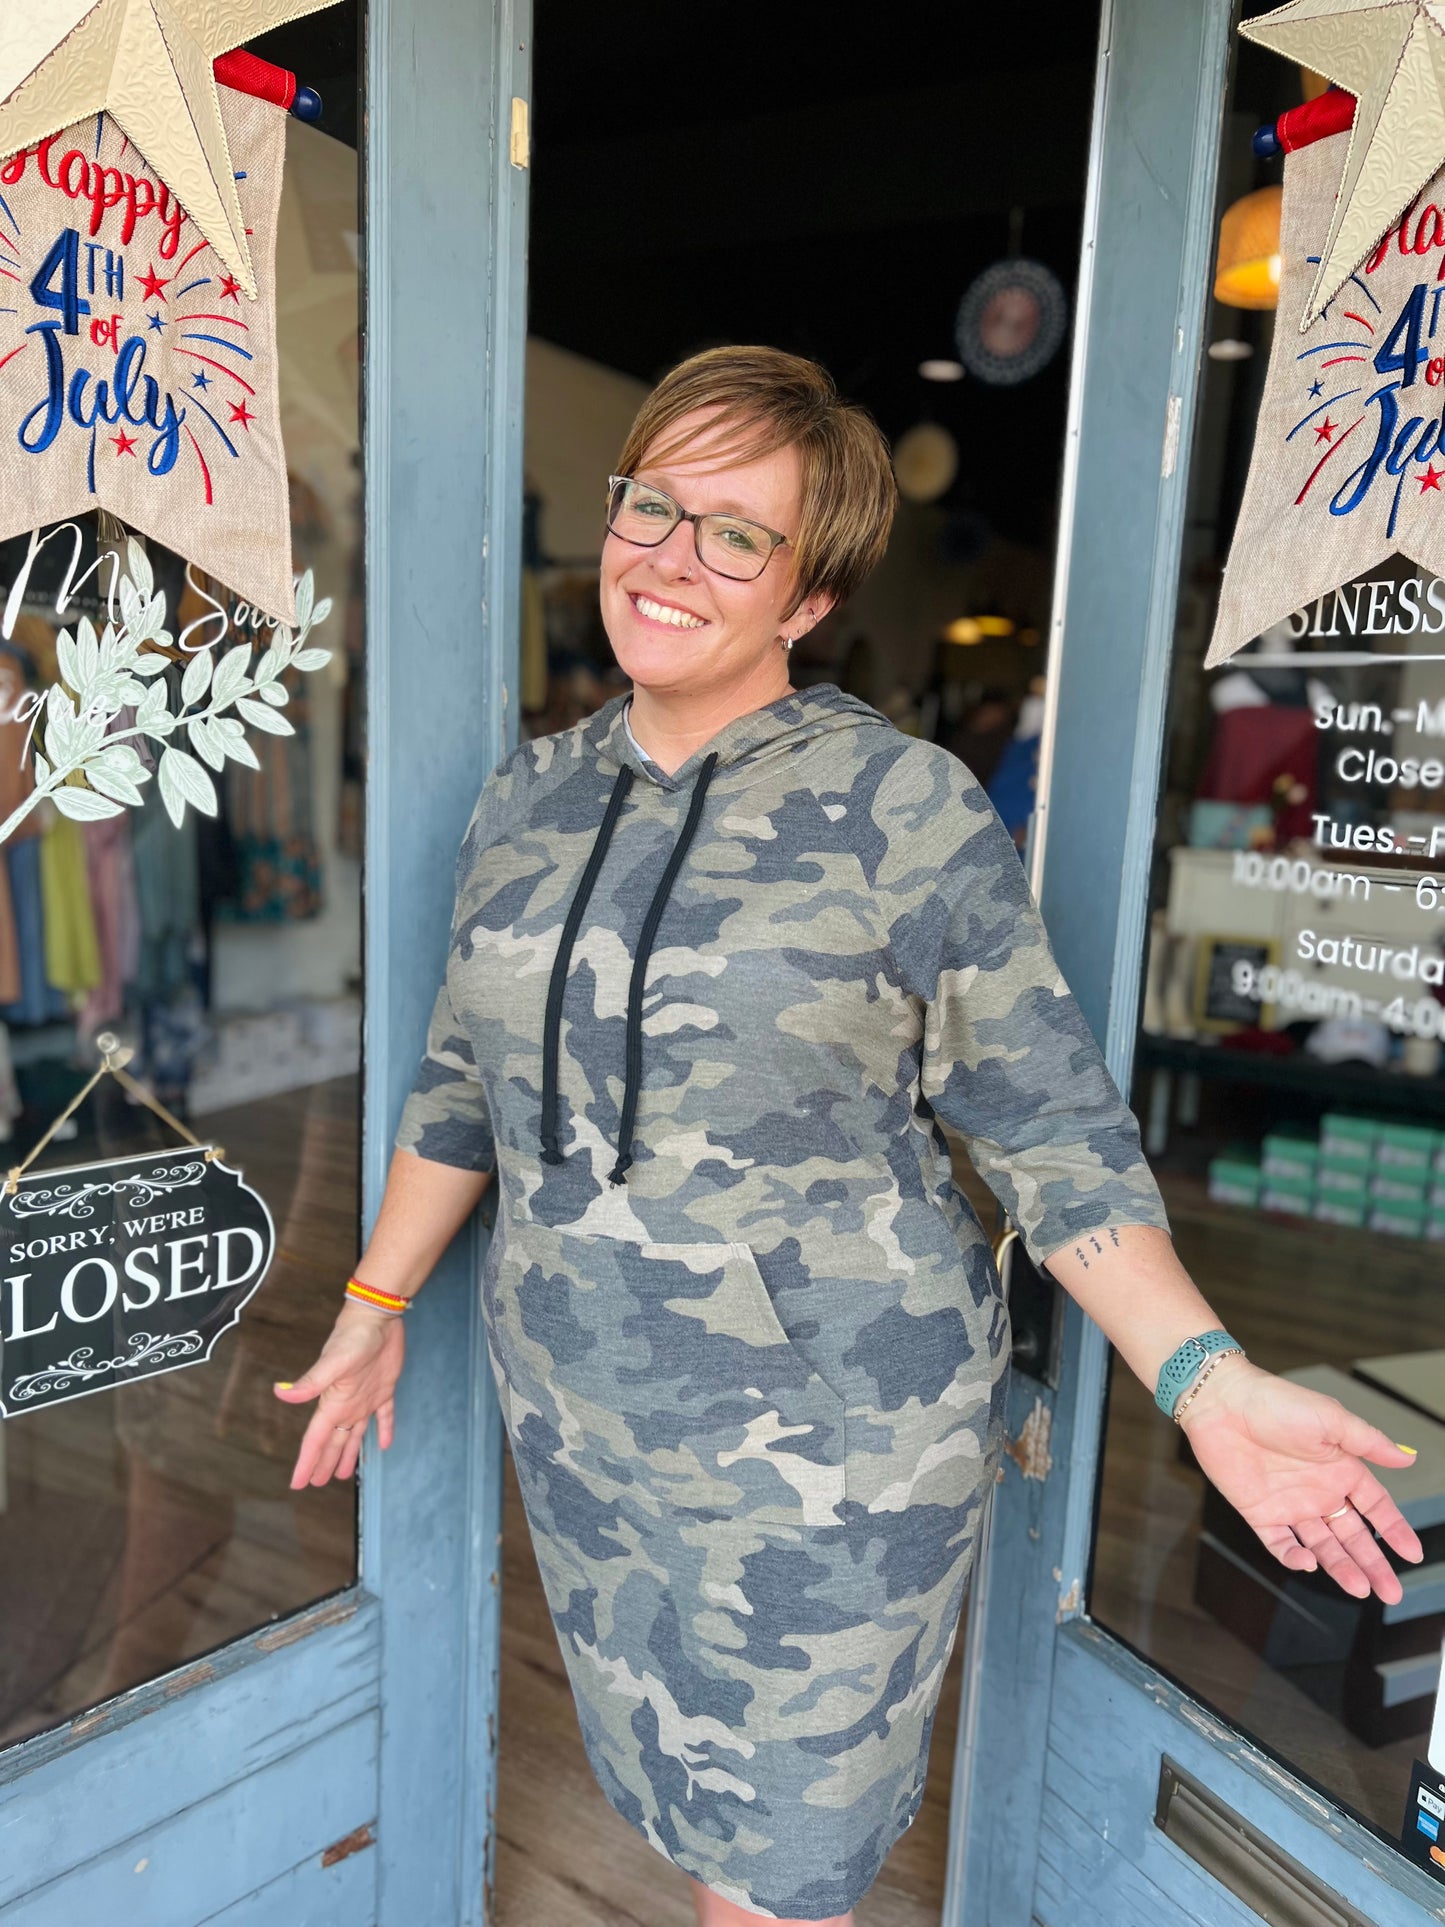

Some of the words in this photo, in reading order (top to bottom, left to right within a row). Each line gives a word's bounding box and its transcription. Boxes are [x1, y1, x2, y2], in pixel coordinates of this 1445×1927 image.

[18, 320, 186, 475] July
[0, 1226, 264, 1342] LOSED
[9, 1224, 116, 1264] SORRY,
[123, 1206, 206, 1238] WE'RE
